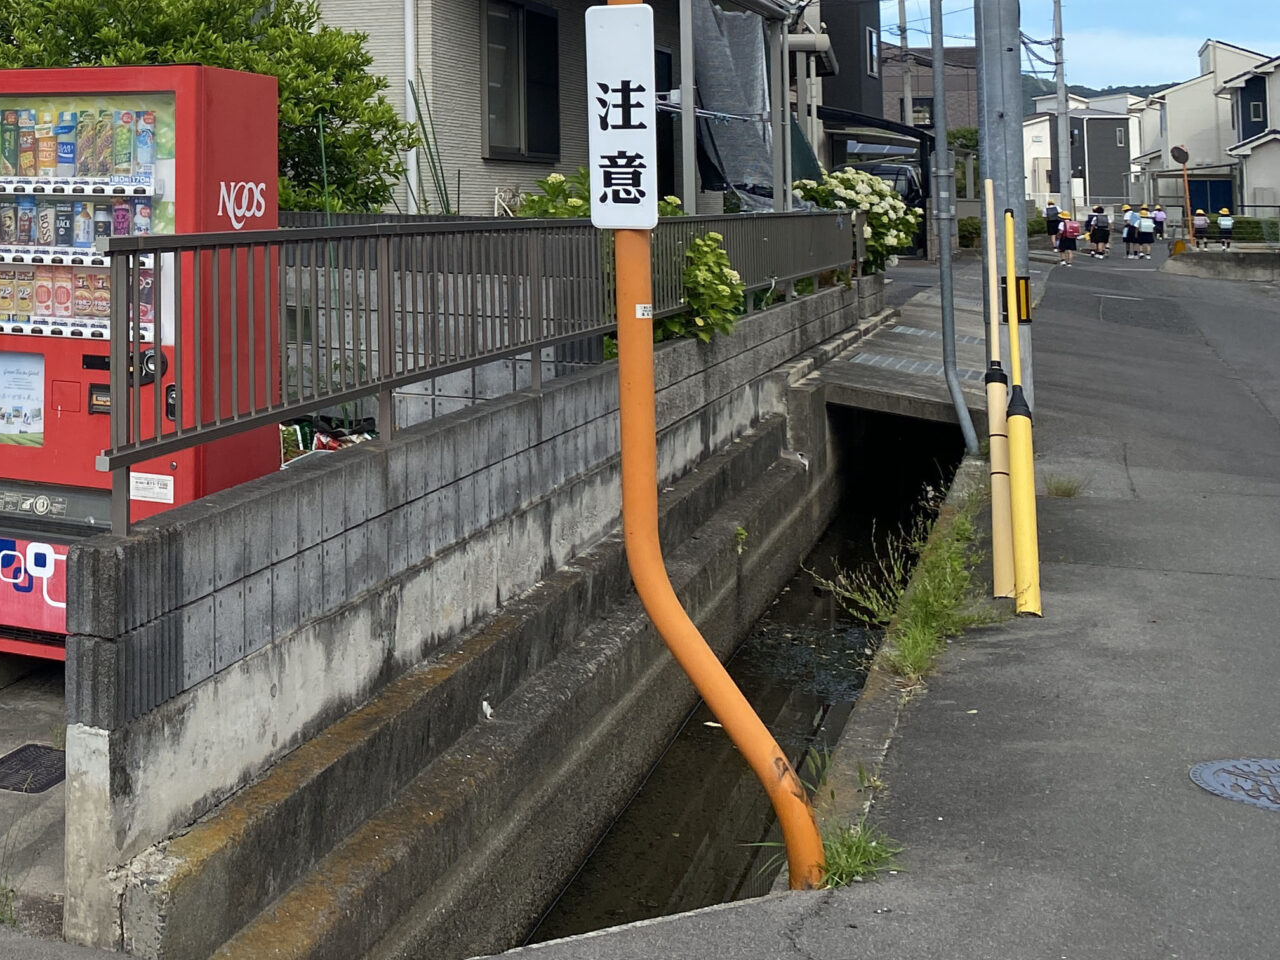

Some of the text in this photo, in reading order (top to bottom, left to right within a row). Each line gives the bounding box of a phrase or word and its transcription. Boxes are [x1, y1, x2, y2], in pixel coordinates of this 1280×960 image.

[596, 80, 647, 204] 注意
[40, 213, 52, 243] BOSS
[217, 181, 266, 230] NOOS
